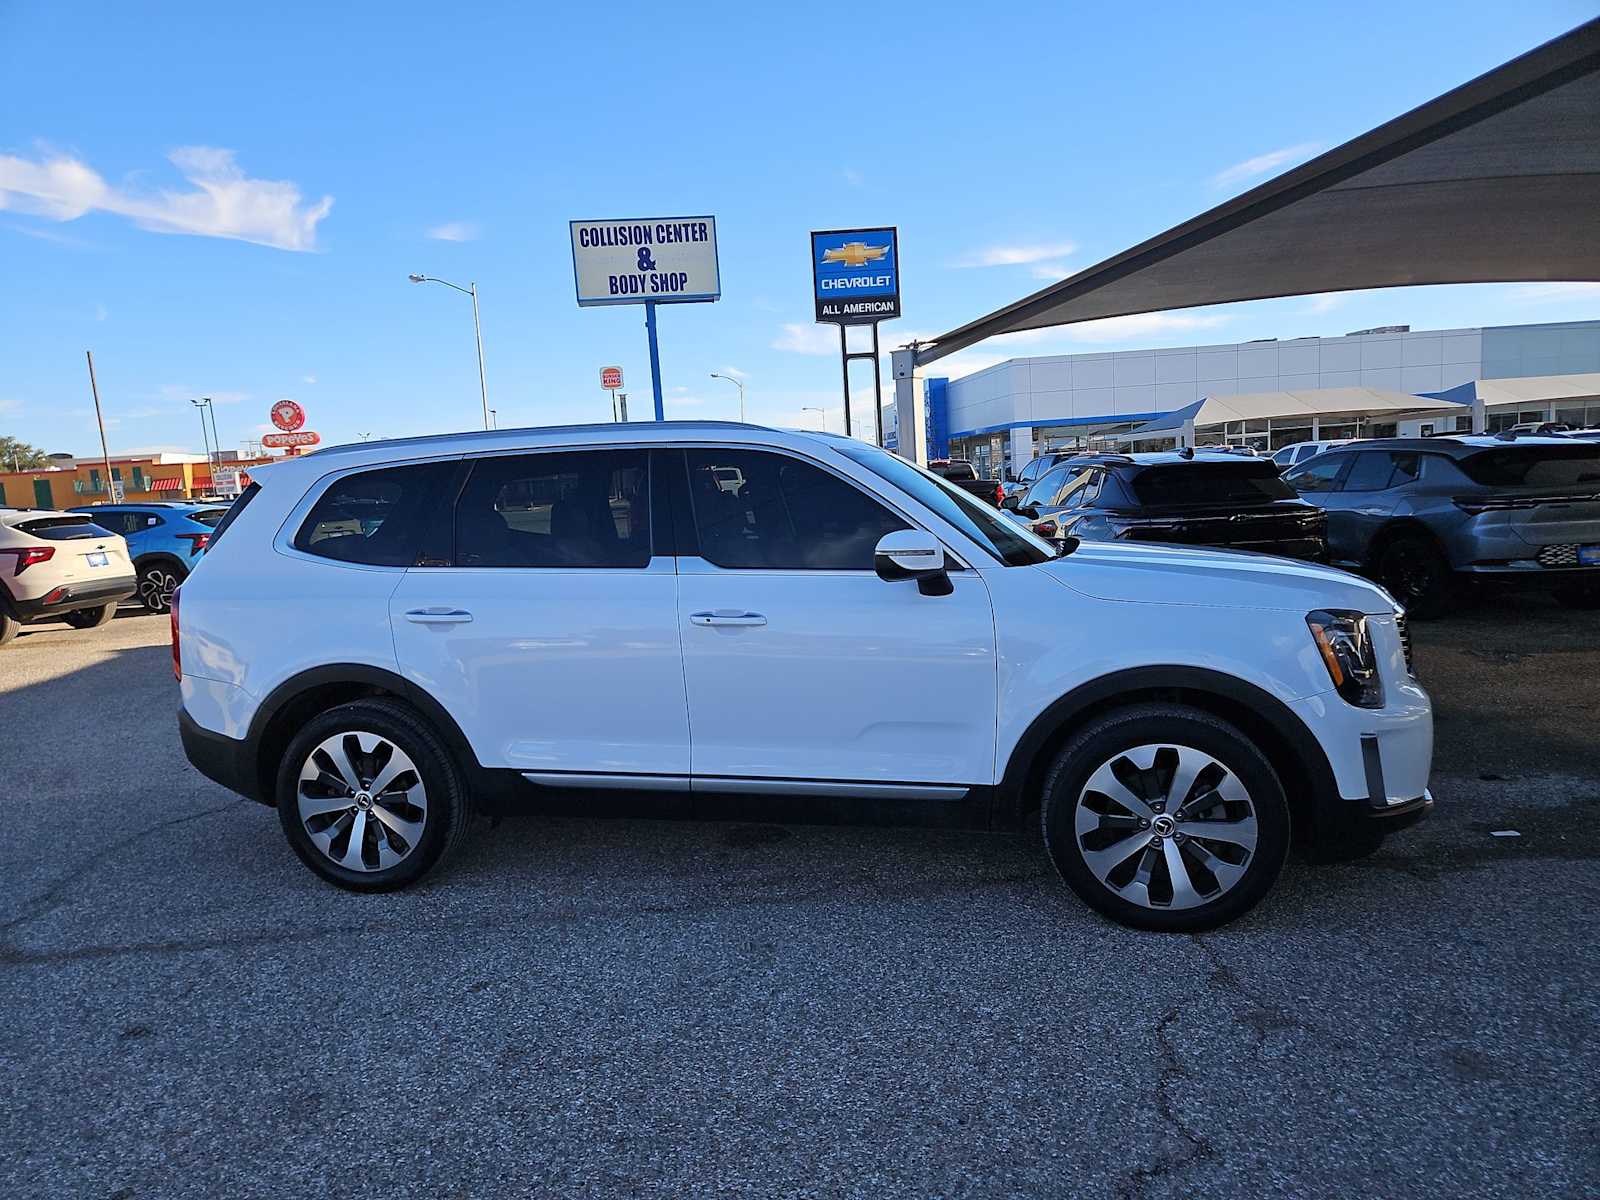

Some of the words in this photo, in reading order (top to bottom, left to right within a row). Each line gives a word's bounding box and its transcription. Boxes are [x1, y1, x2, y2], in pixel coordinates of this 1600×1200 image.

[579, 225, 653, 247] COLLISION
[655, 222, 708, 244] CENTER
[637, 246, 656, 271] &
[608, 274, 646, 295] BODY
[649, 272, 688, 293] SHOP
[821, 275, 891, 290] CHEVROLET
[822, 304, 841, 315] ALL
[843, 301, 894, 314] AMERICAN
